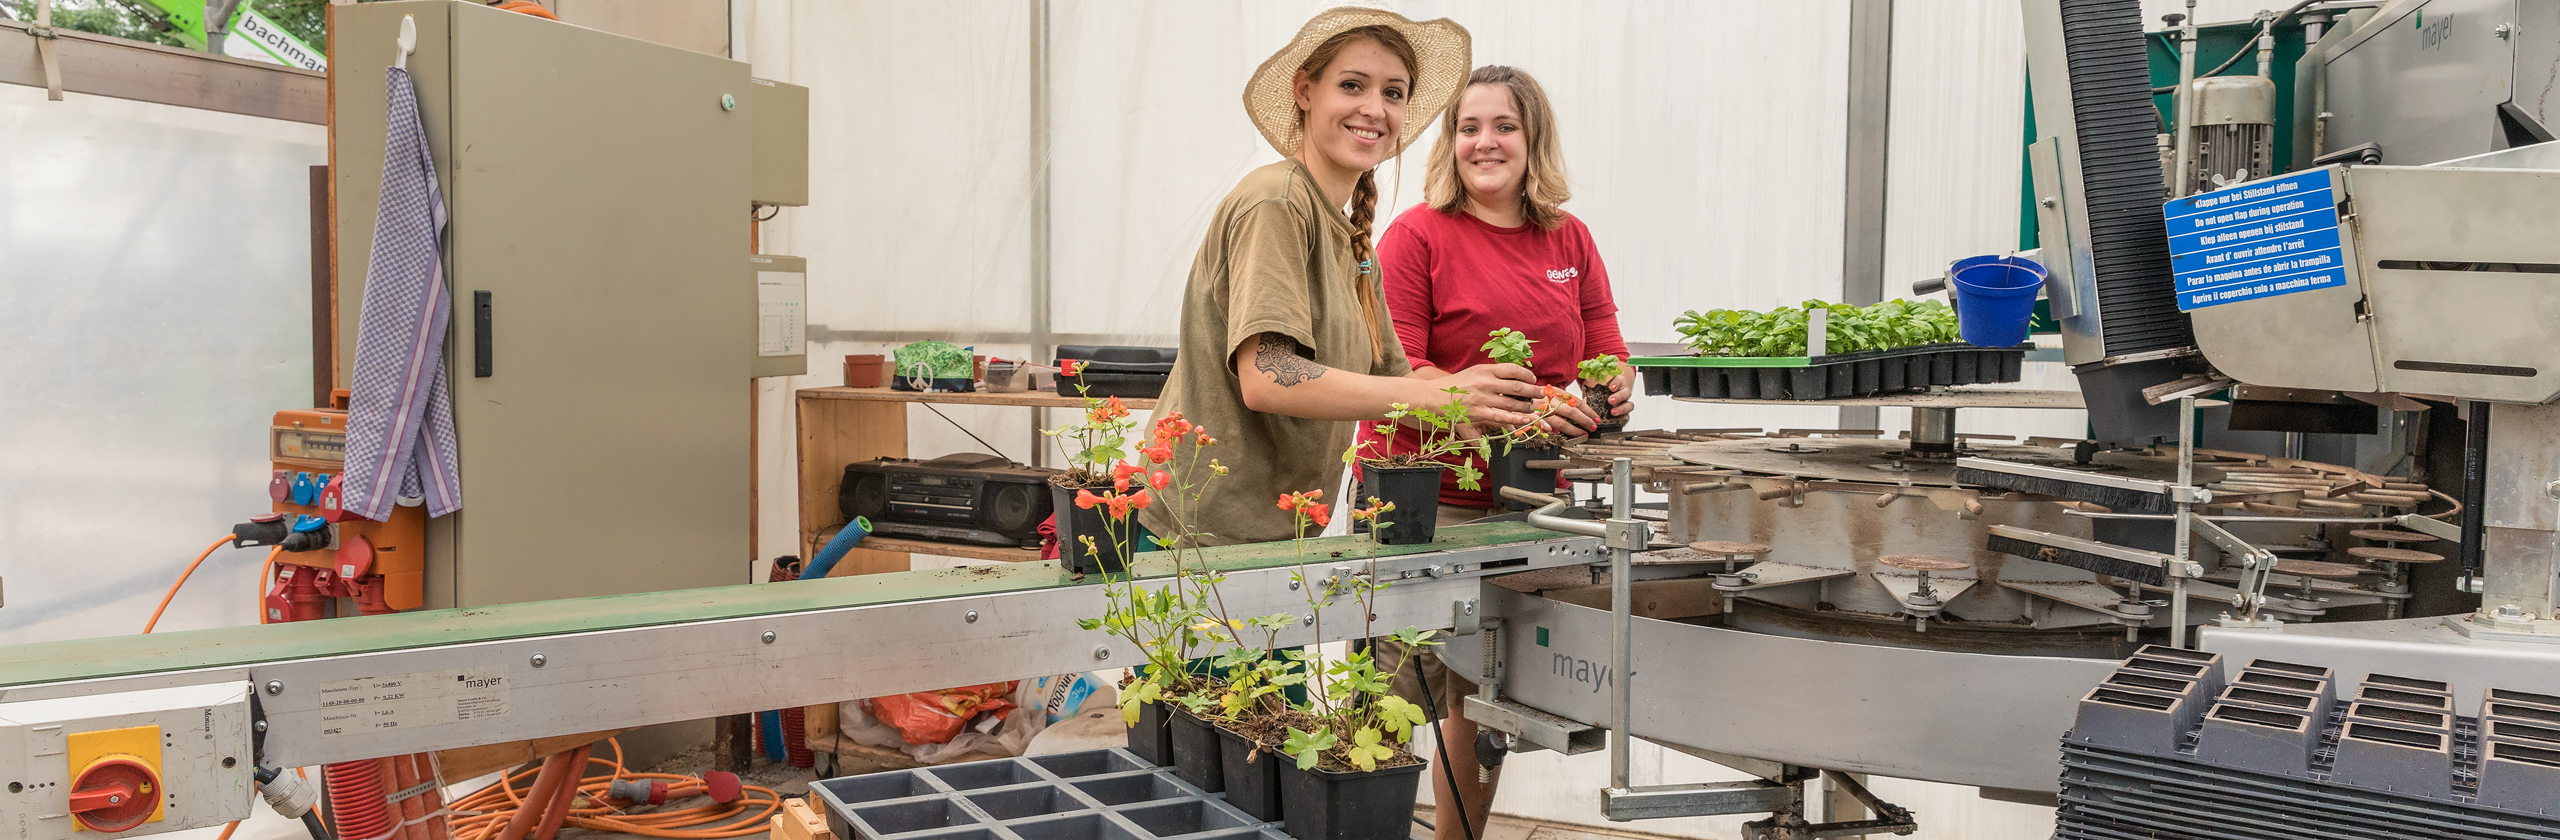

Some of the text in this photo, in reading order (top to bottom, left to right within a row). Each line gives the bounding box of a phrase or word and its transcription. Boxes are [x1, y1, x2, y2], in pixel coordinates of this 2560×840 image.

[2422, 13, 2454, 51] mayer
[2195, 182, 2298, 208] Klappe nur bei Stillstand öffnen
[2195, 200, 2304, 228] Do not open flap during operation
[2200, 219, 2304, 246] Klep alleen openen bij stilstand
[2206, 253, 2225, 264] Avant
[2233, 248, 2253, 260] ouvrir
[2254, 244, 2282, 256] attendre
[2283, 238, 2305, 251] l'arrêt
[2187, 255, 2331, 286] Parar la maquina antes de abrir la trampilla
[2192, 275, 2332, 304] Aprire il coperchio solo a macchina ferma
[466, 677, 502, 688] mayer
[1553, 652, 1637, 694] may
